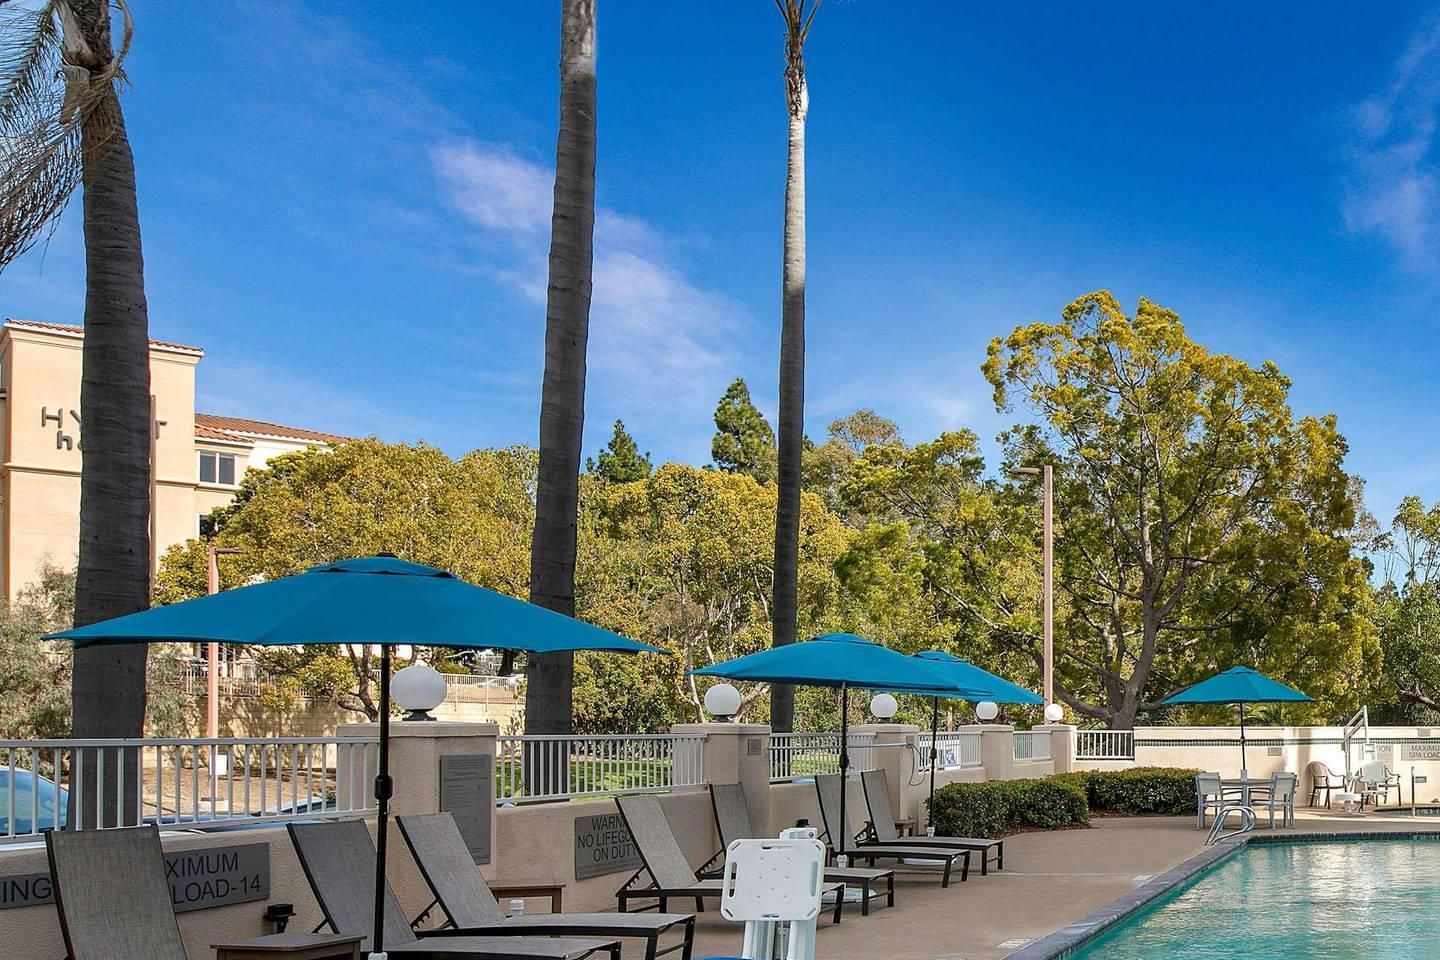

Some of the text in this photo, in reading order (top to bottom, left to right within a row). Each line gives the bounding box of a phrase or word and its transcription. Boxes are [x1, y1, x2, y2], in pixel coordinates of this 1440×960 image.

[592, 815, 624, 831] WARN
[577, 830, 632, 848] NO LIFEGU
[593, 844, 637, 862] ON DUTY
[165, 852, 239, 878] XIMUM
[3, 877, 52, 903] ING
[173, 873, 262, 904] LOAD-14
